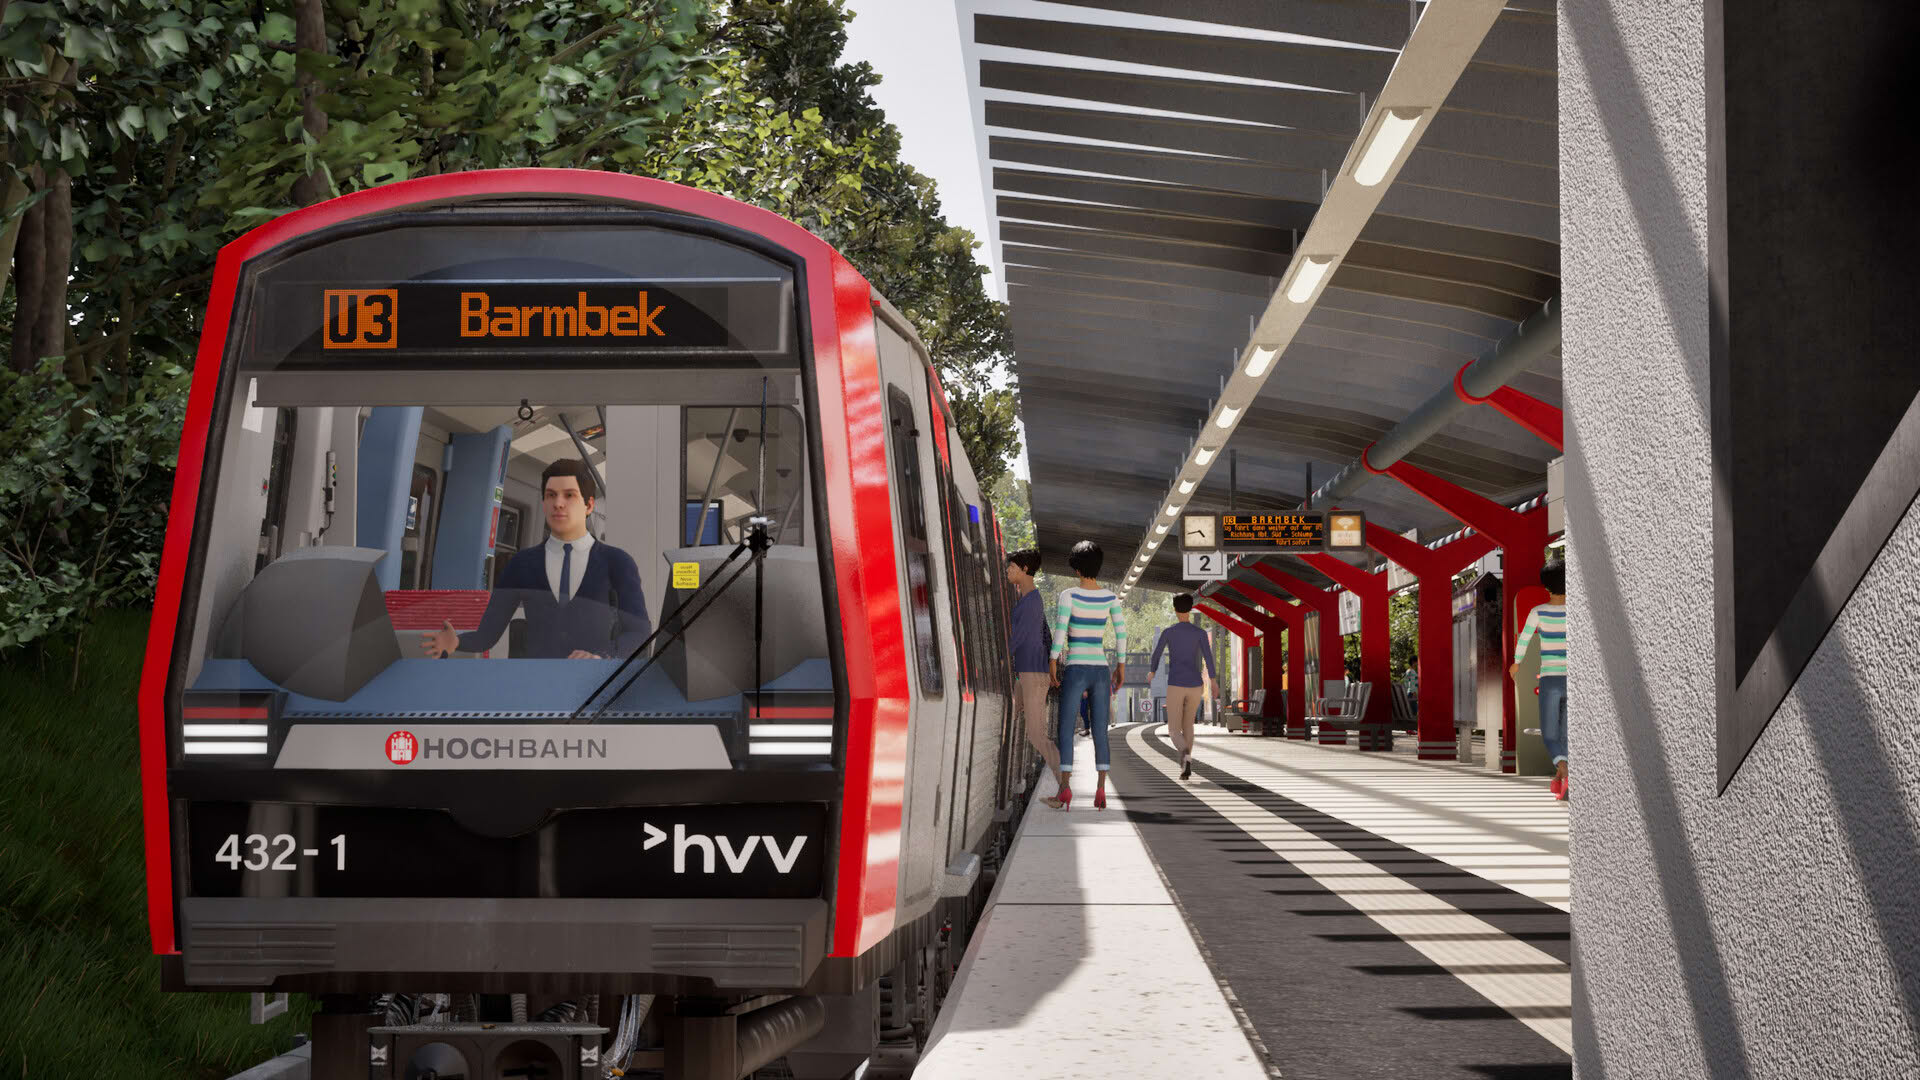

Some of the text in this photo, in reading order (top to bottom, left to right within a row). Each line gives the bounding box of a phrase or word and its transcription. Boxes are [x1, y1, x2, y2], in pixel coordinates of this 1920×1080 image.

[326, 290, 667, 346] U3 Barmbek
[1224, 515, 1305, 525] U3 BARMBEK
[1199, 555, 1211, 572] 2
[423, 737, 608, 760] HOCHBAHN
